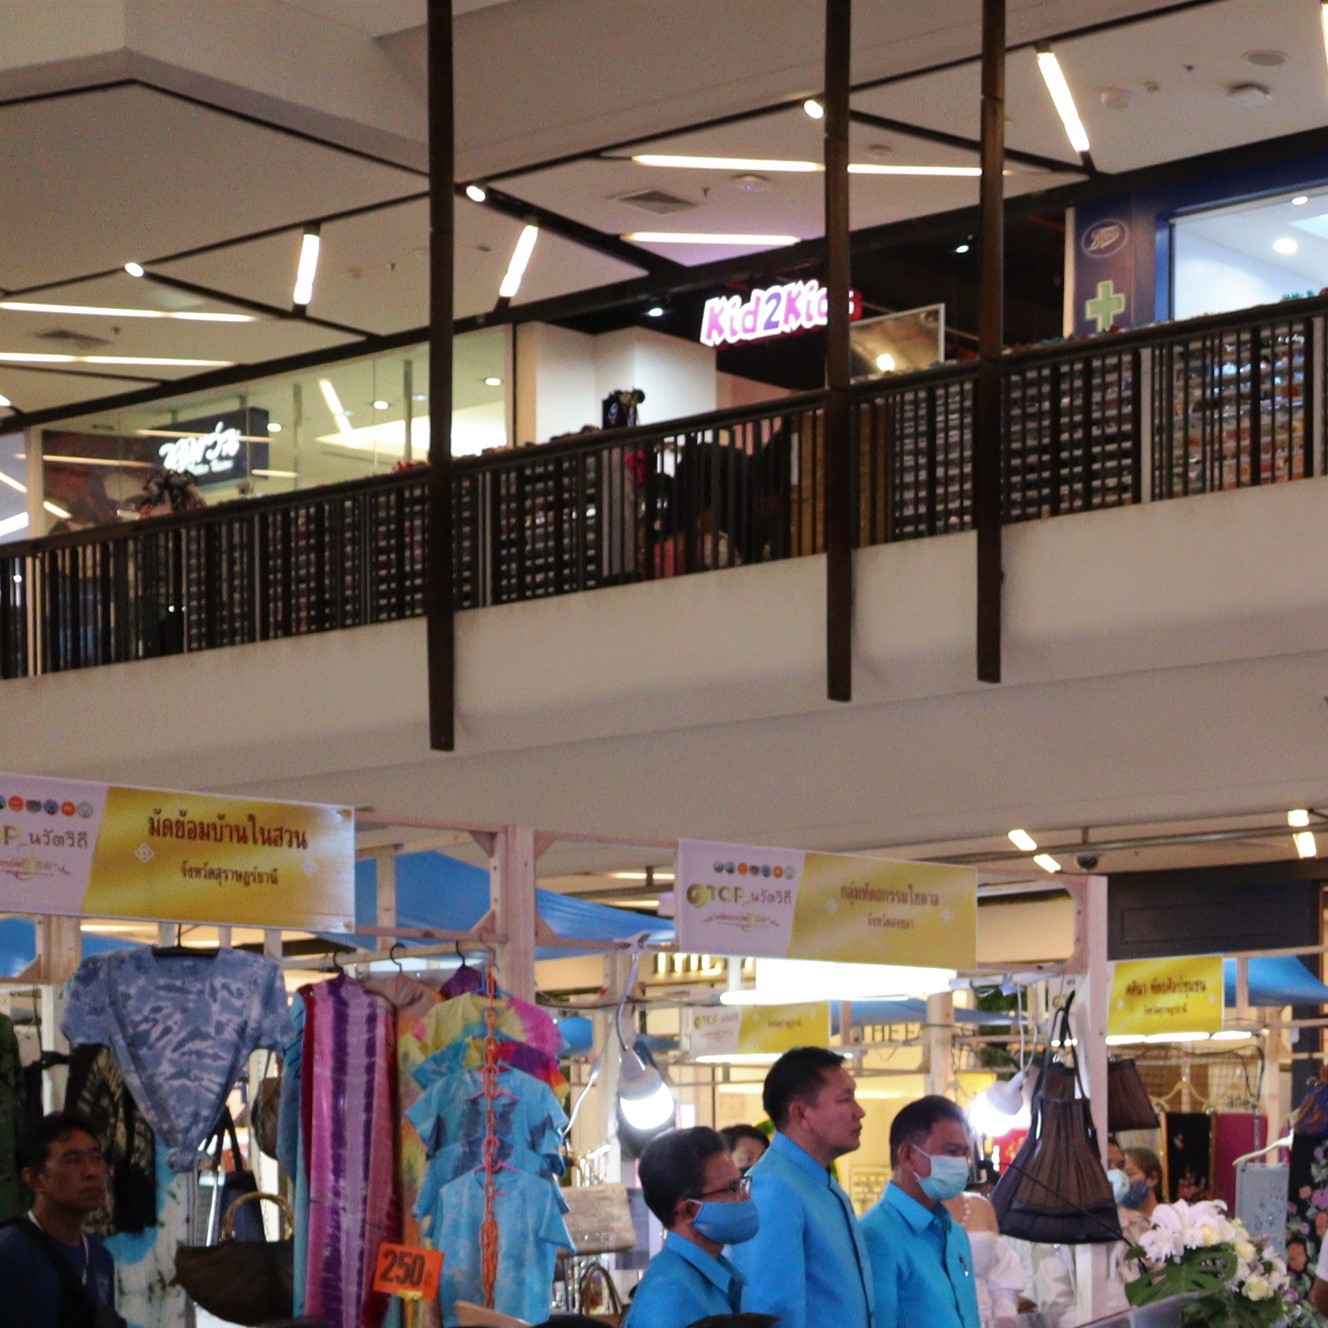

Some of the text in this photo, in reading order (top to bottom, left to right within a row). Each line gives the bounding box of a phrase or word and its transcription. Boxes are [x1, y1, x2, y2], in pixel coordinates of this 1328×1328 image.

[148, 808, 308, 850] มัดย้อมบ้านในสวน
[380, 1249, 426, 1287] 250
